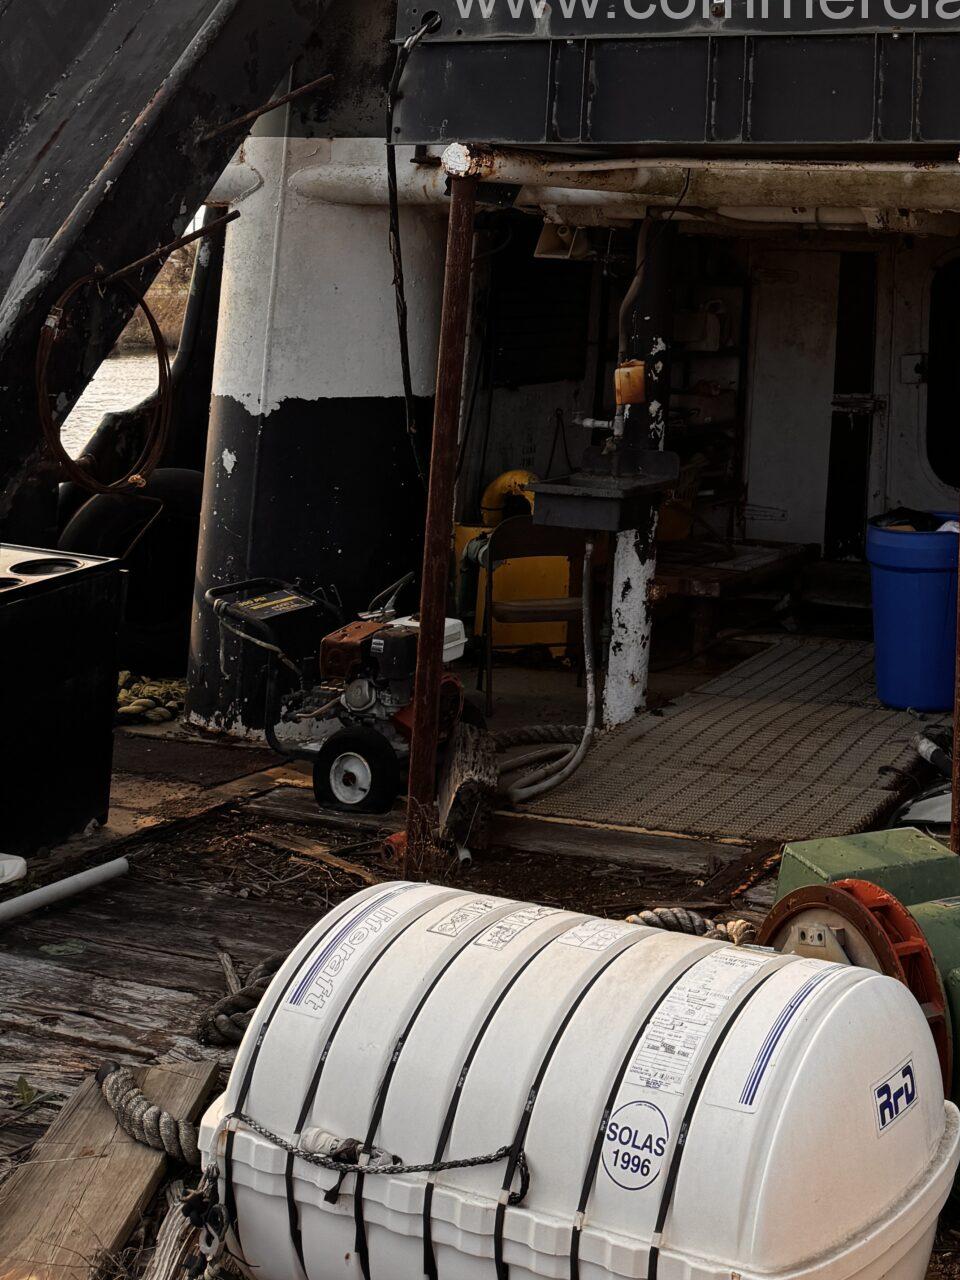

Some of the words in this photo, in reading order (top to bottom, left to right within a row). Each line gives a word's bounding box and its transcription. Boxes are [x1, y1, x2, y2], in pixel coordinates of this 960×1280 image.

[304, 905, 399, 1011] liferaft
[606, 1122, 666, 1156] SOLAS
[613, 1148, 651, 1176] 1996
